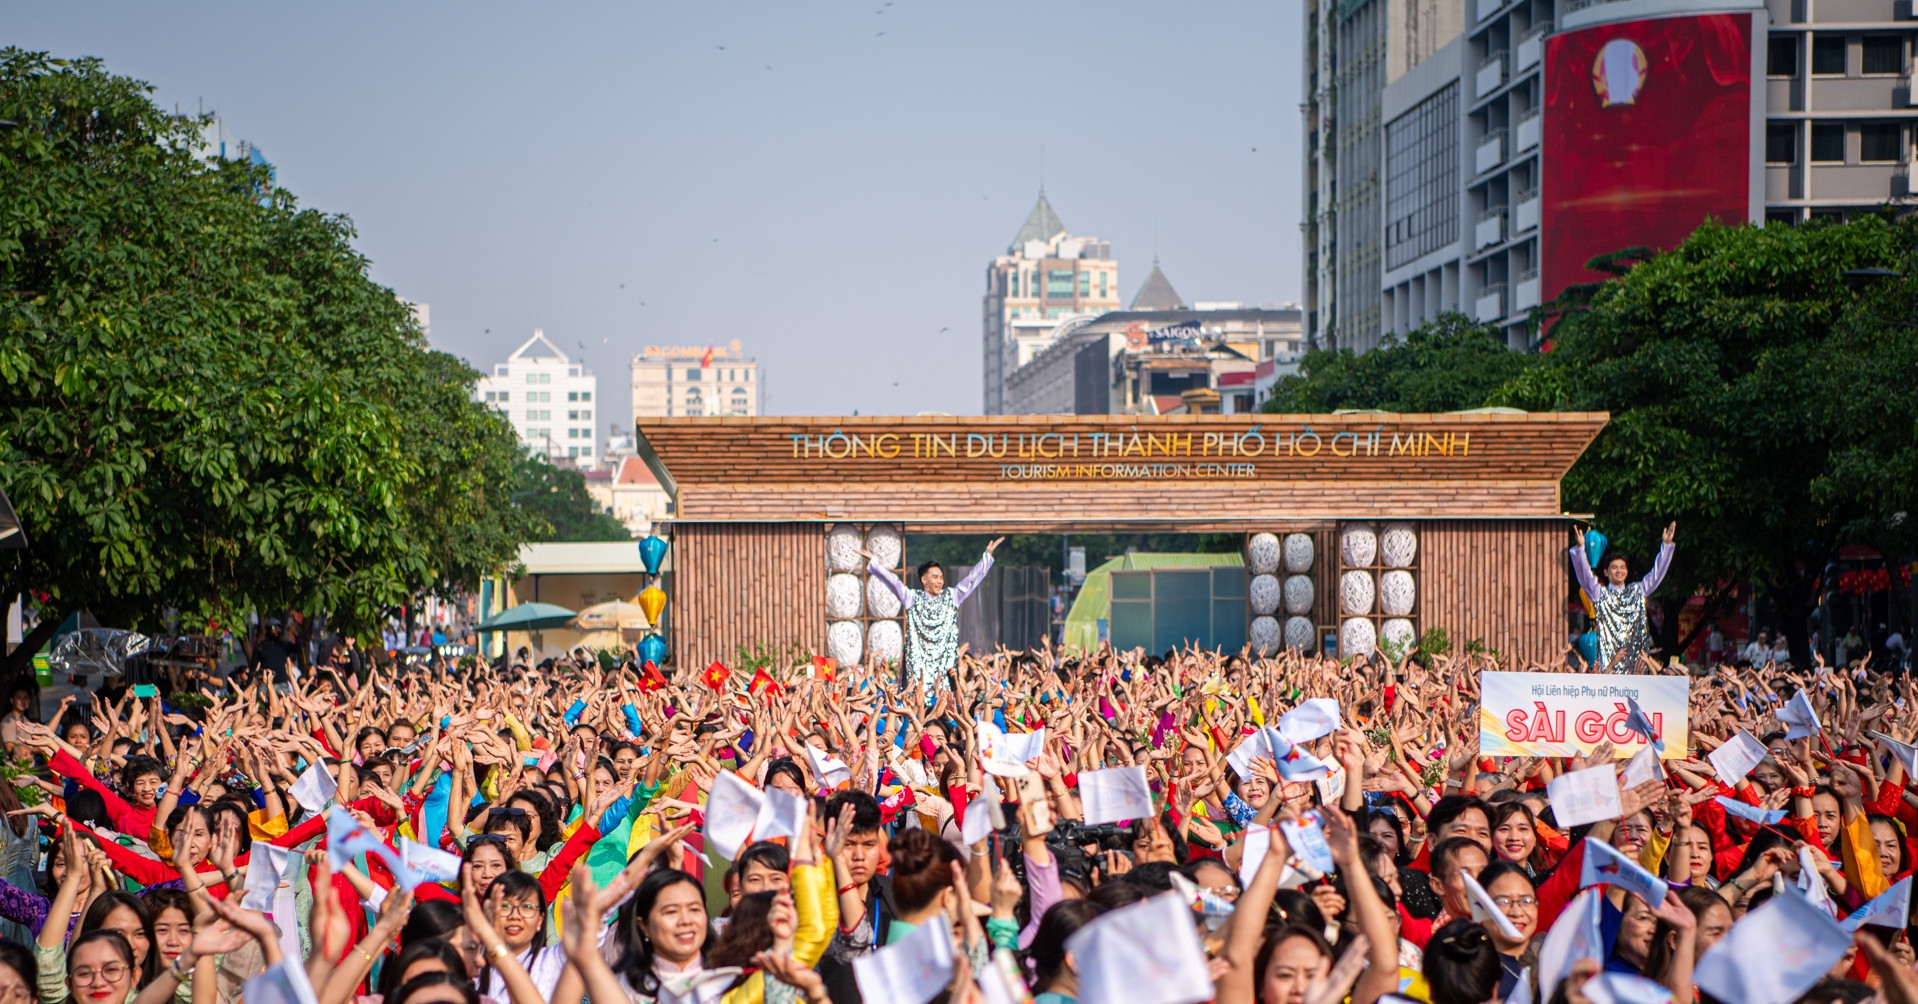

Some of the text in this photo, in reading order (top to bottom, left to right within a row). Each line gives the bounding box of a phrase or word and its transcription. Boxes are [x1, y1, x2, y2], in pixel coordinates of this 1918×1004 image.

[788, 423, 1470, 462] THÔNG TIN DU LỊCH THÀNH PHỐ HỒ CHÍ MINH
[1000, 463, 1256, 479] TOURISM INFORMATION CENTER
[1531, 684, 1639, 701] Hội Liên hiệp Phụ nữ Phường
[1505, 701, 1663, 745] SÀI GÒN
